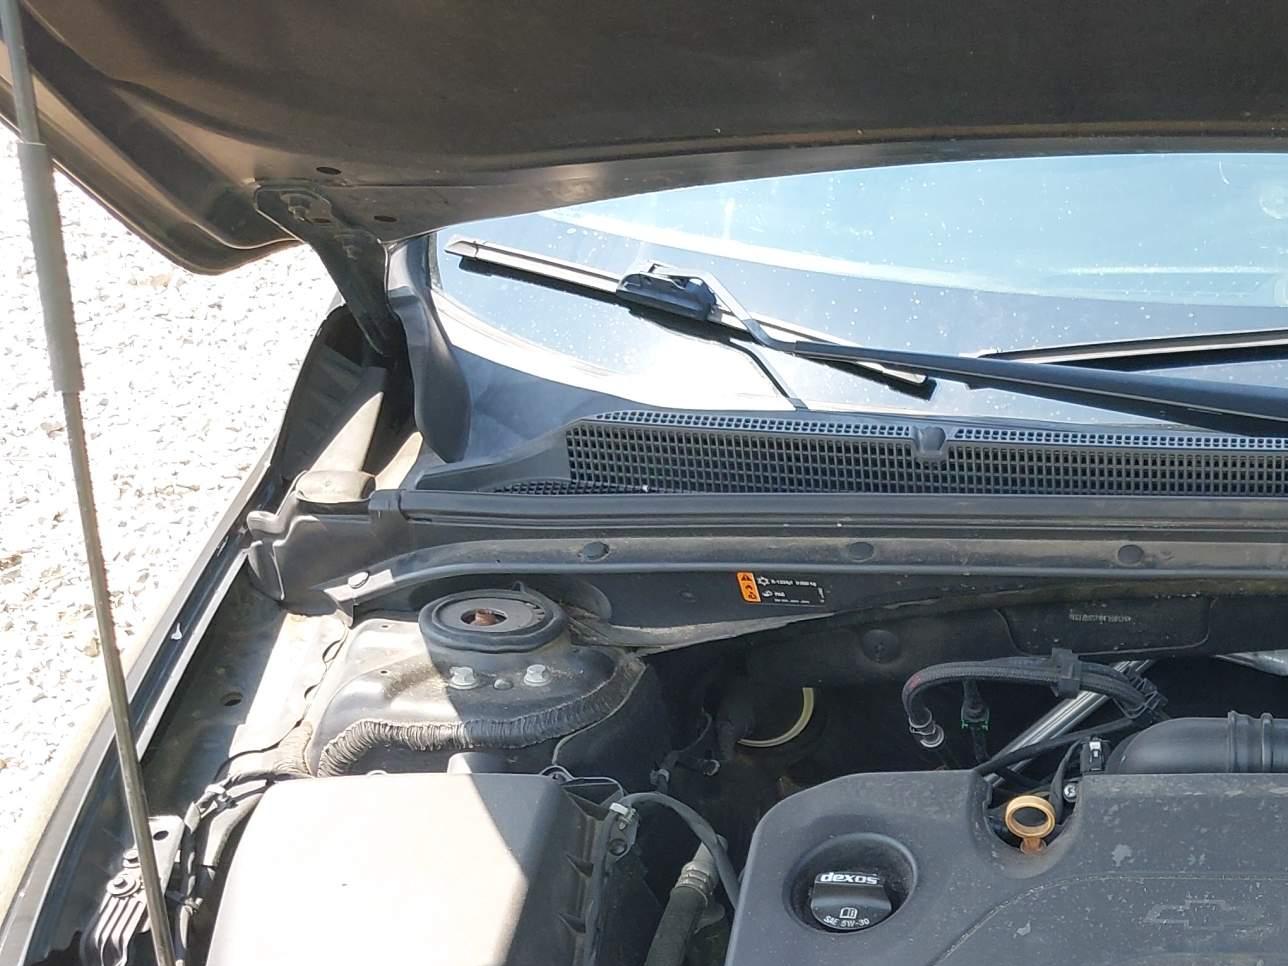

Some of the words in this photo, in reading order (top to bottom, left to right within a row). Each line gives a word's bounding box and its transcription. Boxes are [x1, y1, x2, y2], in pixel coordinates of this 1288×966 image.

[820, 872, 880, 885] dexos
[823, 915, 839, 926] SAE
[840, 918, 870, 927] 5W-30
